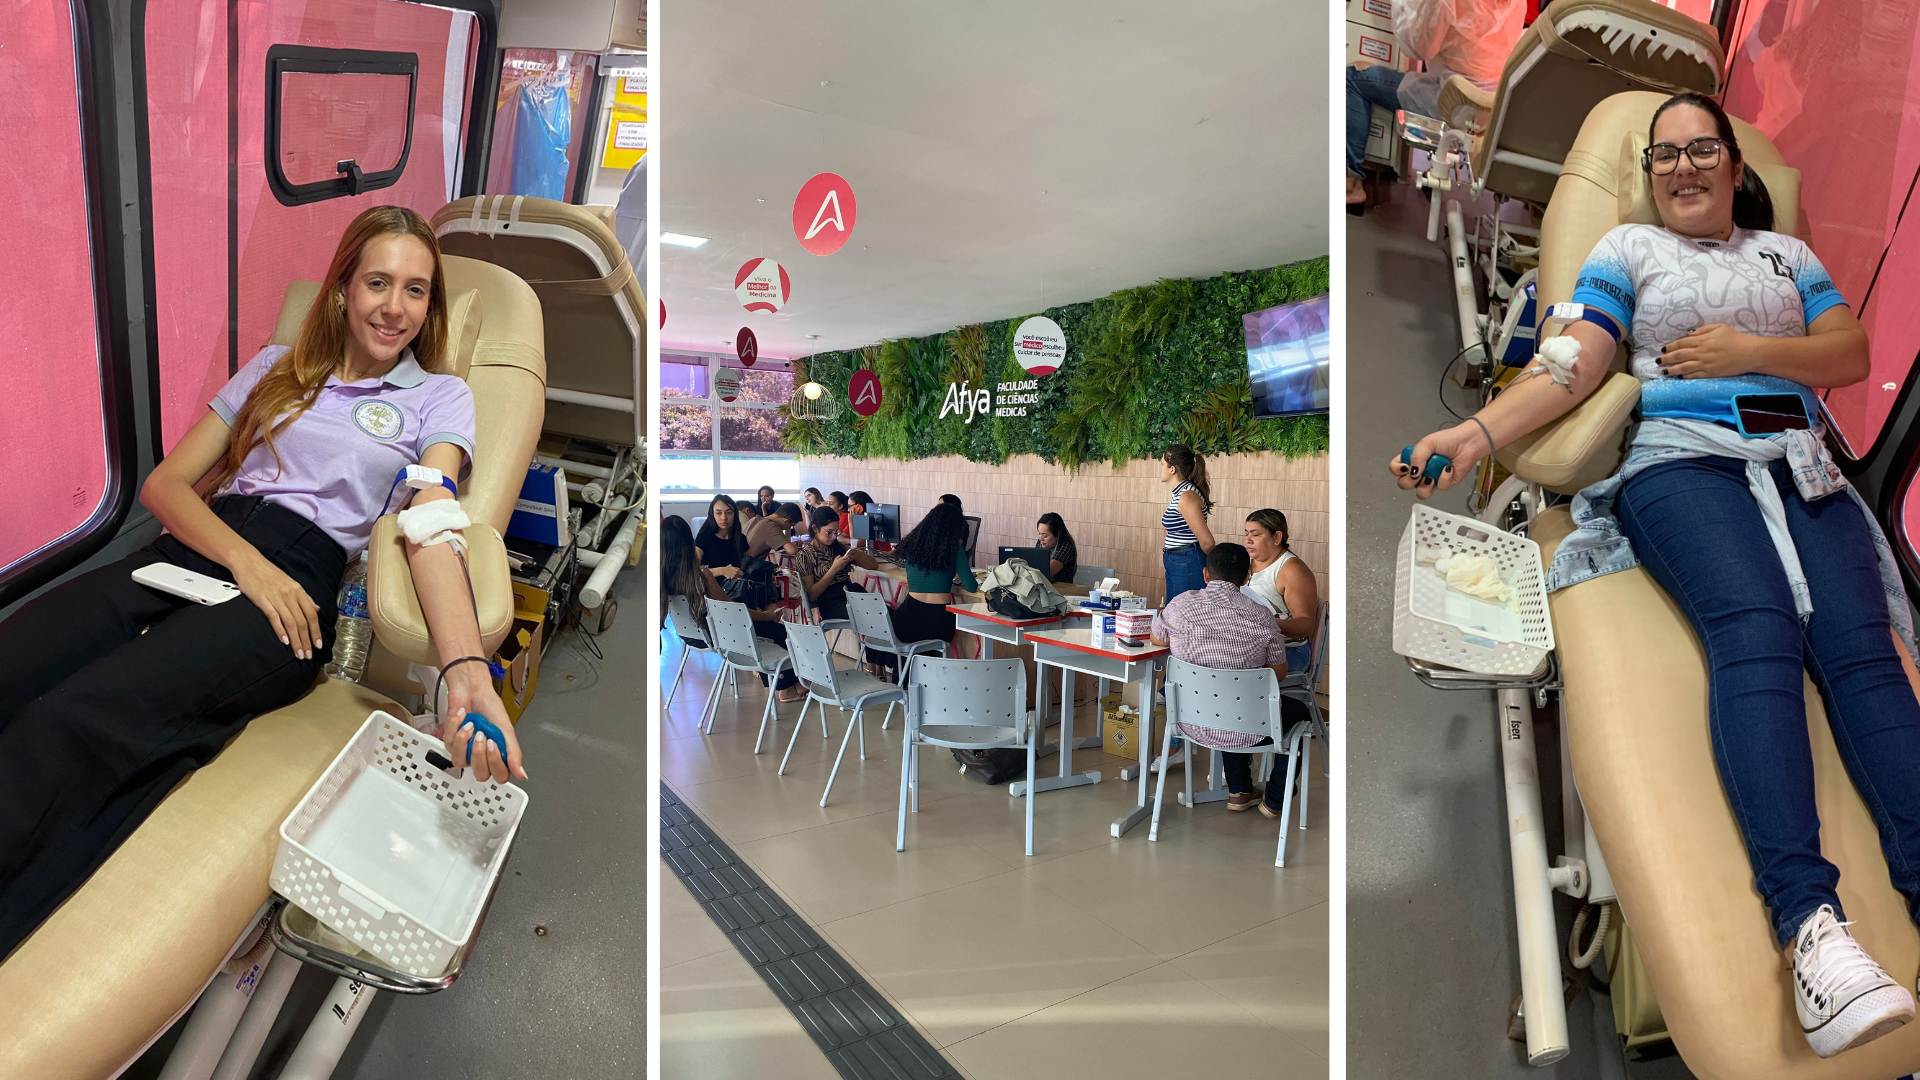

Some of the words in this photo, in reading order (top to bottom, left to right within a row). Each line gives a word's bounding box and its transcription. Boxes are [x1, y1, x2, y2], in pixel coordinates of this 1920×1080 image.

[996, 379, 1039, 393] FACULDADE
[938, 379, 991, 424] Afya
[996, 395, 1006, 405] DE
[1007, 391, 1040, 405] CIÊNCIAS
